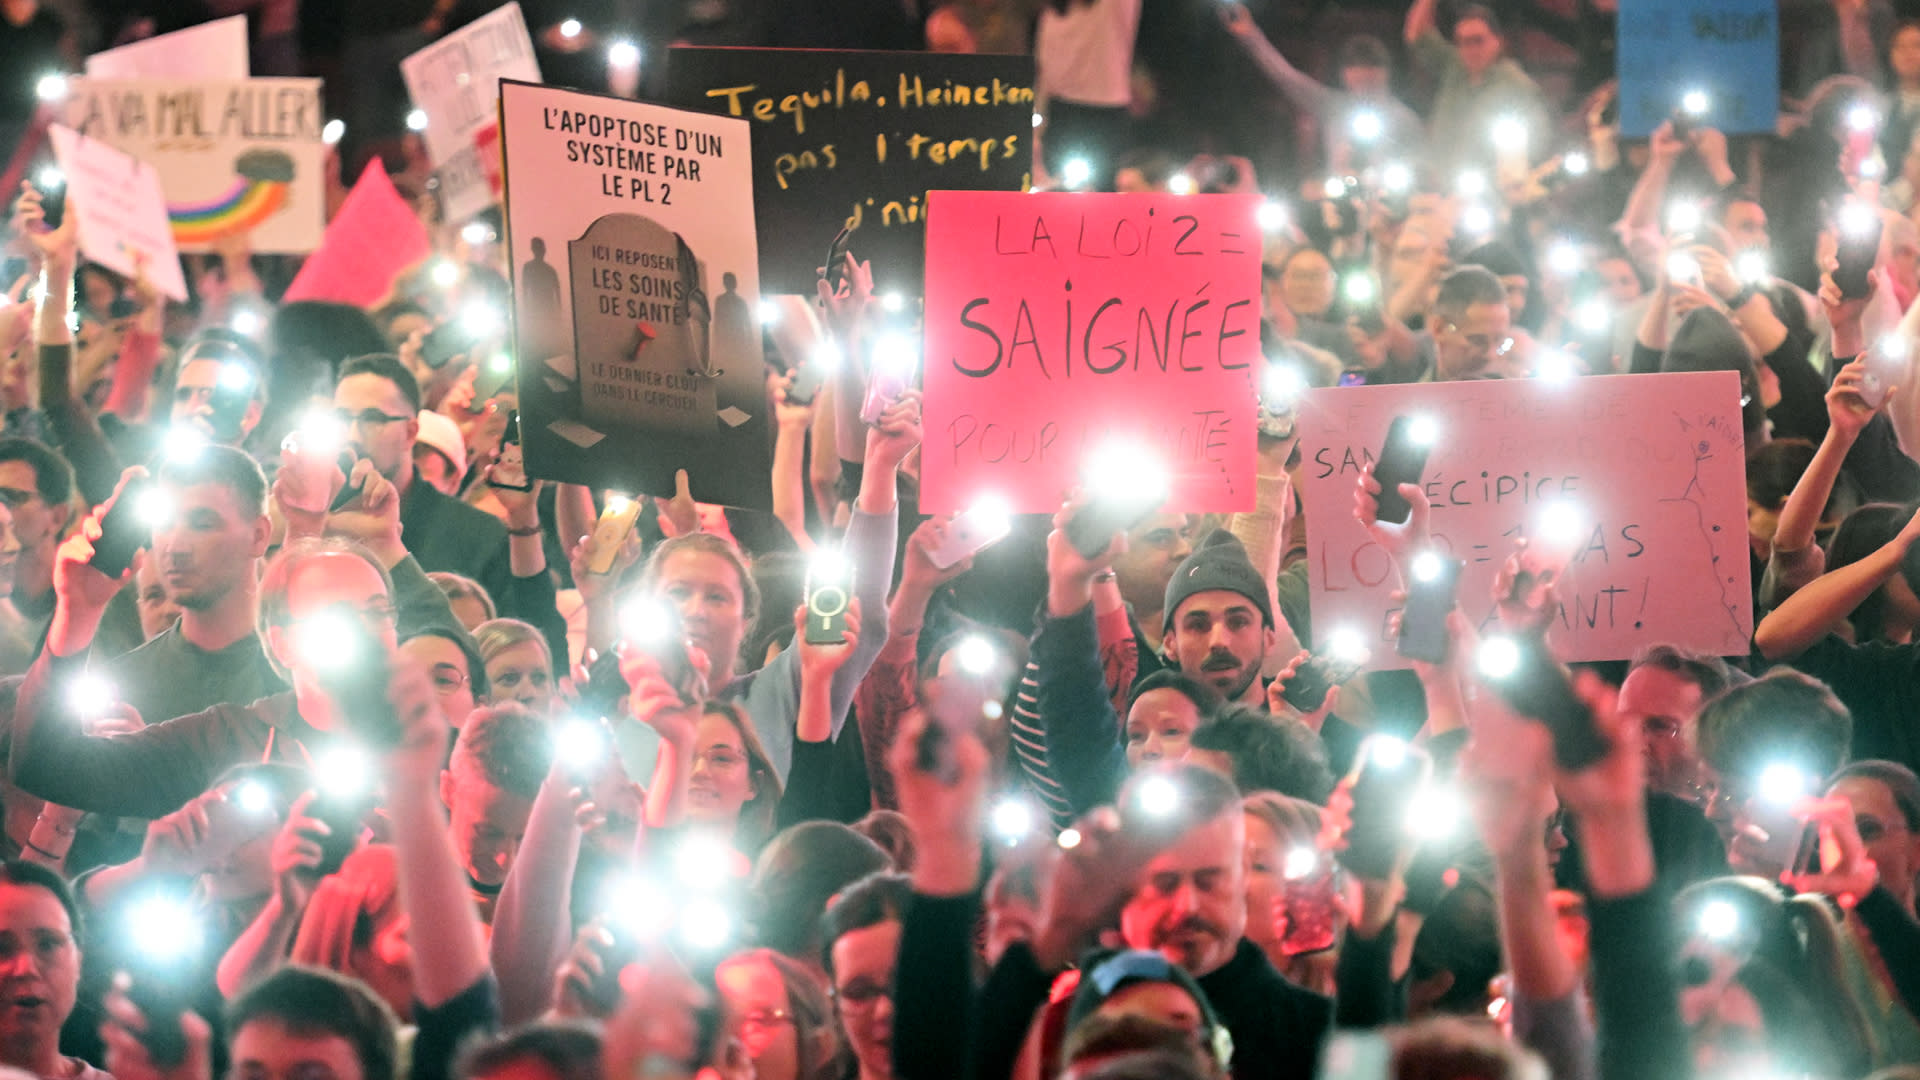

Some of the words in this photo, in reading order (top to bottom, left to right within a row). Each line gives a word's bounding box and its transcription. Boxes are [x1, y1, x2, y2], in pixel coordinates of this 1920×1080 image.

[899, 73, 1034, 108] Heineken
[156, 87, 212, 137] MAL
[544, 107, 668, 148] L'APOPTOSE
[676, 129, 723, 158] D'UN
[567, 139, 657, 174] SYSTÈME
[664, 156, 701, 182] PAR
[602, 173, 624, 198] LE
[632, 178, 654, 202] PL
[660, 183, 672, 205] 2
[996, 215, 1057, 259] LA
[1172, 215, 1204, 256] 2
[592, 245, 610, 262] ICI
[615, 248, 681, 272] REPOSENT
[592, 268, 623, 292] LES
[629, 273, 684, 300] SOINS
[599, 295, 620, 317] DE
[627, 301, 684, 326] SANTÉ
[591, 362, 603, 378] LE
